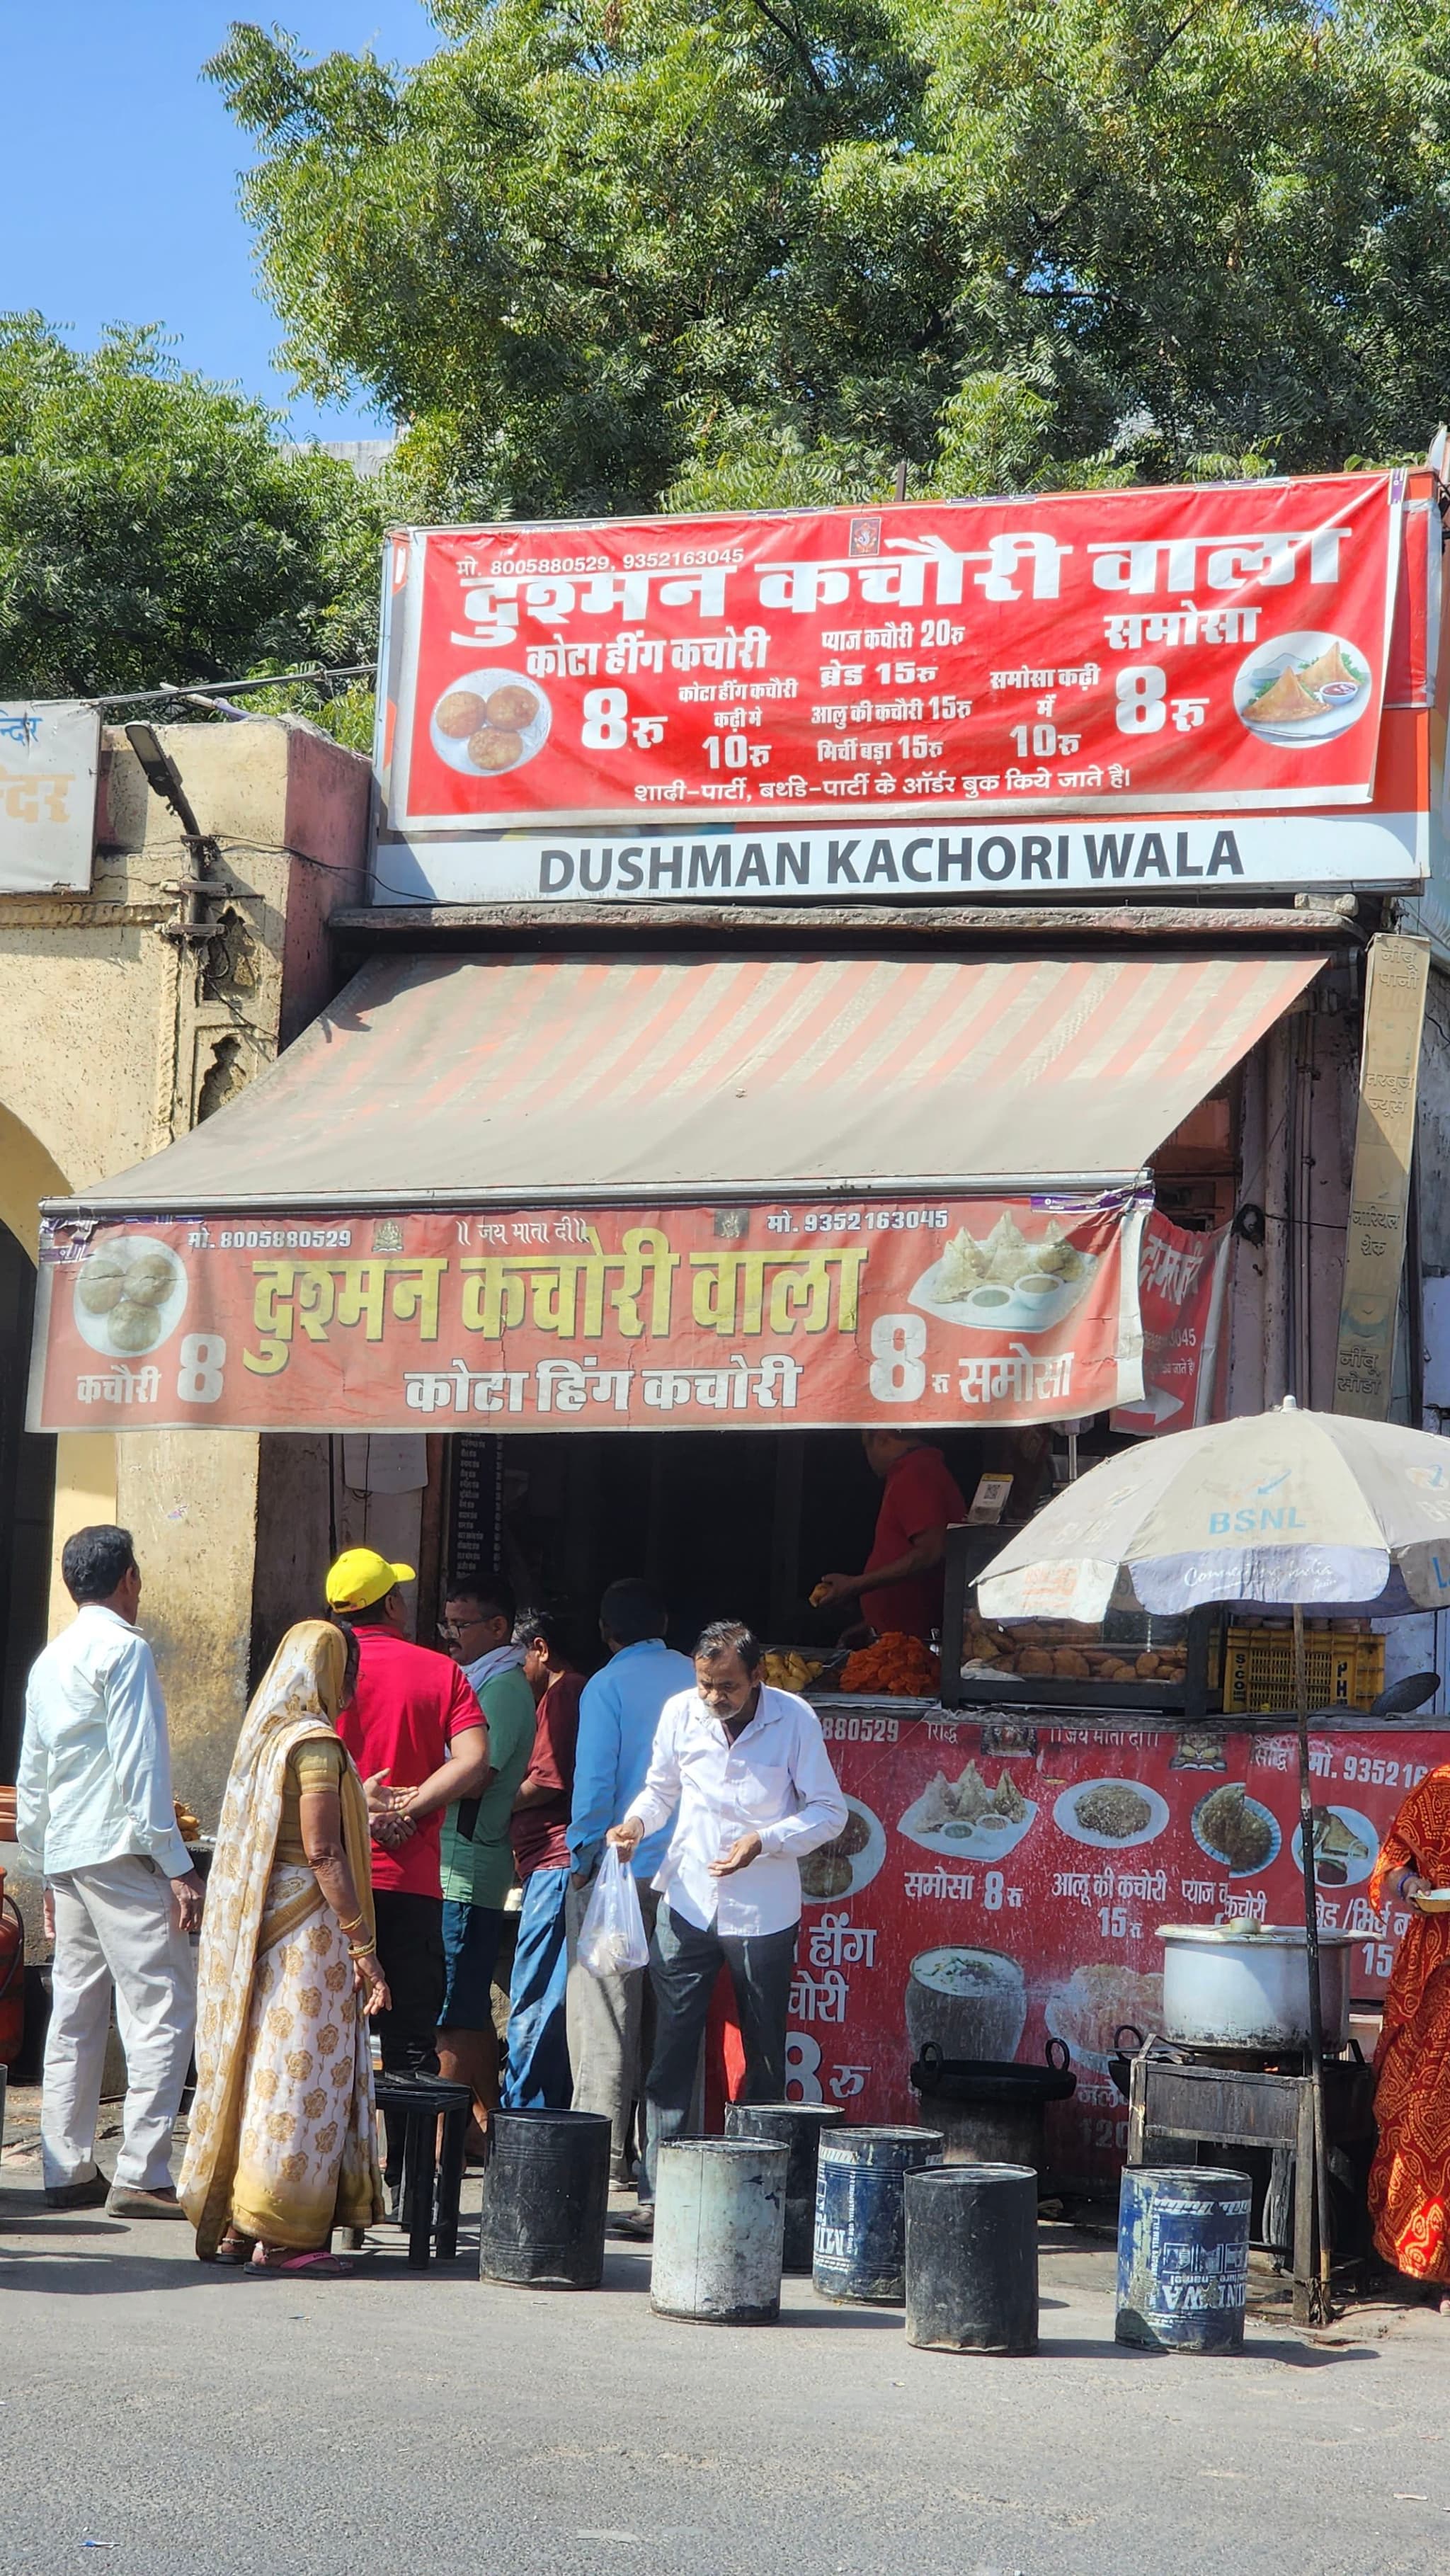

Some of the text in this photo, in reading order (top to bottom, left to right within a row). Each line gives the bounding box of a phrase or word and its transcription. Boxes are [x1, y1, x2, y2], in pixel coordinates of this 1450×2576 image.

[456, 547, 745, 576] मो. 8005880529, 9352163045
[450, 528, 1352, 647] दुश्मन कचौरी वाला
[821, 629, 861, 651] प्याज
[864, 622, 915, 649] कचौरी
[1104, 600, 1262, 651] समोसा
[526, 626, 772, 678] कोटा हींग कचोरी
[678, 676, 799, 702] कोटा हींग कचौरी
[819, 659, 866, 688] ब्रेड
[990, 664, 1055, 690] समोसा
[850, 703, 874, 724] की
[1036, 694, 1056, 717] में
[874, 772, 896, 794] के
[901, 770, 956, 794] ऑर्डर
[961, 773, 1000, 798] बुक
[1005, 766, 1052, 791] किये
[1057, 765, 1103, 788] जाते
[539, 830, 1245, 894] DUSHMAN KACHORI WALA
[187, 1226, 352, 1250] मो. 8005880529
[477, 1223, 506, 1244] जय
[511, 1221, 549, 1245] माता
[767, 1211, 799, 1234] मो.
[243, 1258, 449, 1377] दुश्मन
[690, 1247, 869, 1338] वाला
[77, 1333, 227, 1405] कचौरी 8
[403, 1353, 804, 1413] कोटा हिंग कचोरी
[958, 1342, 1075, 1404] समोसा
[1209, 1505, 1307, 1536] BSNL
[903, 1866, 976, 1900] समोसा
[1051, 1872, 1092, 1907] आलू
[1092, 1866, 1114, 1898] की
[1181, 1879, 1216, 1905] प्याज
[809, 1912, 878, 1968] हींग
